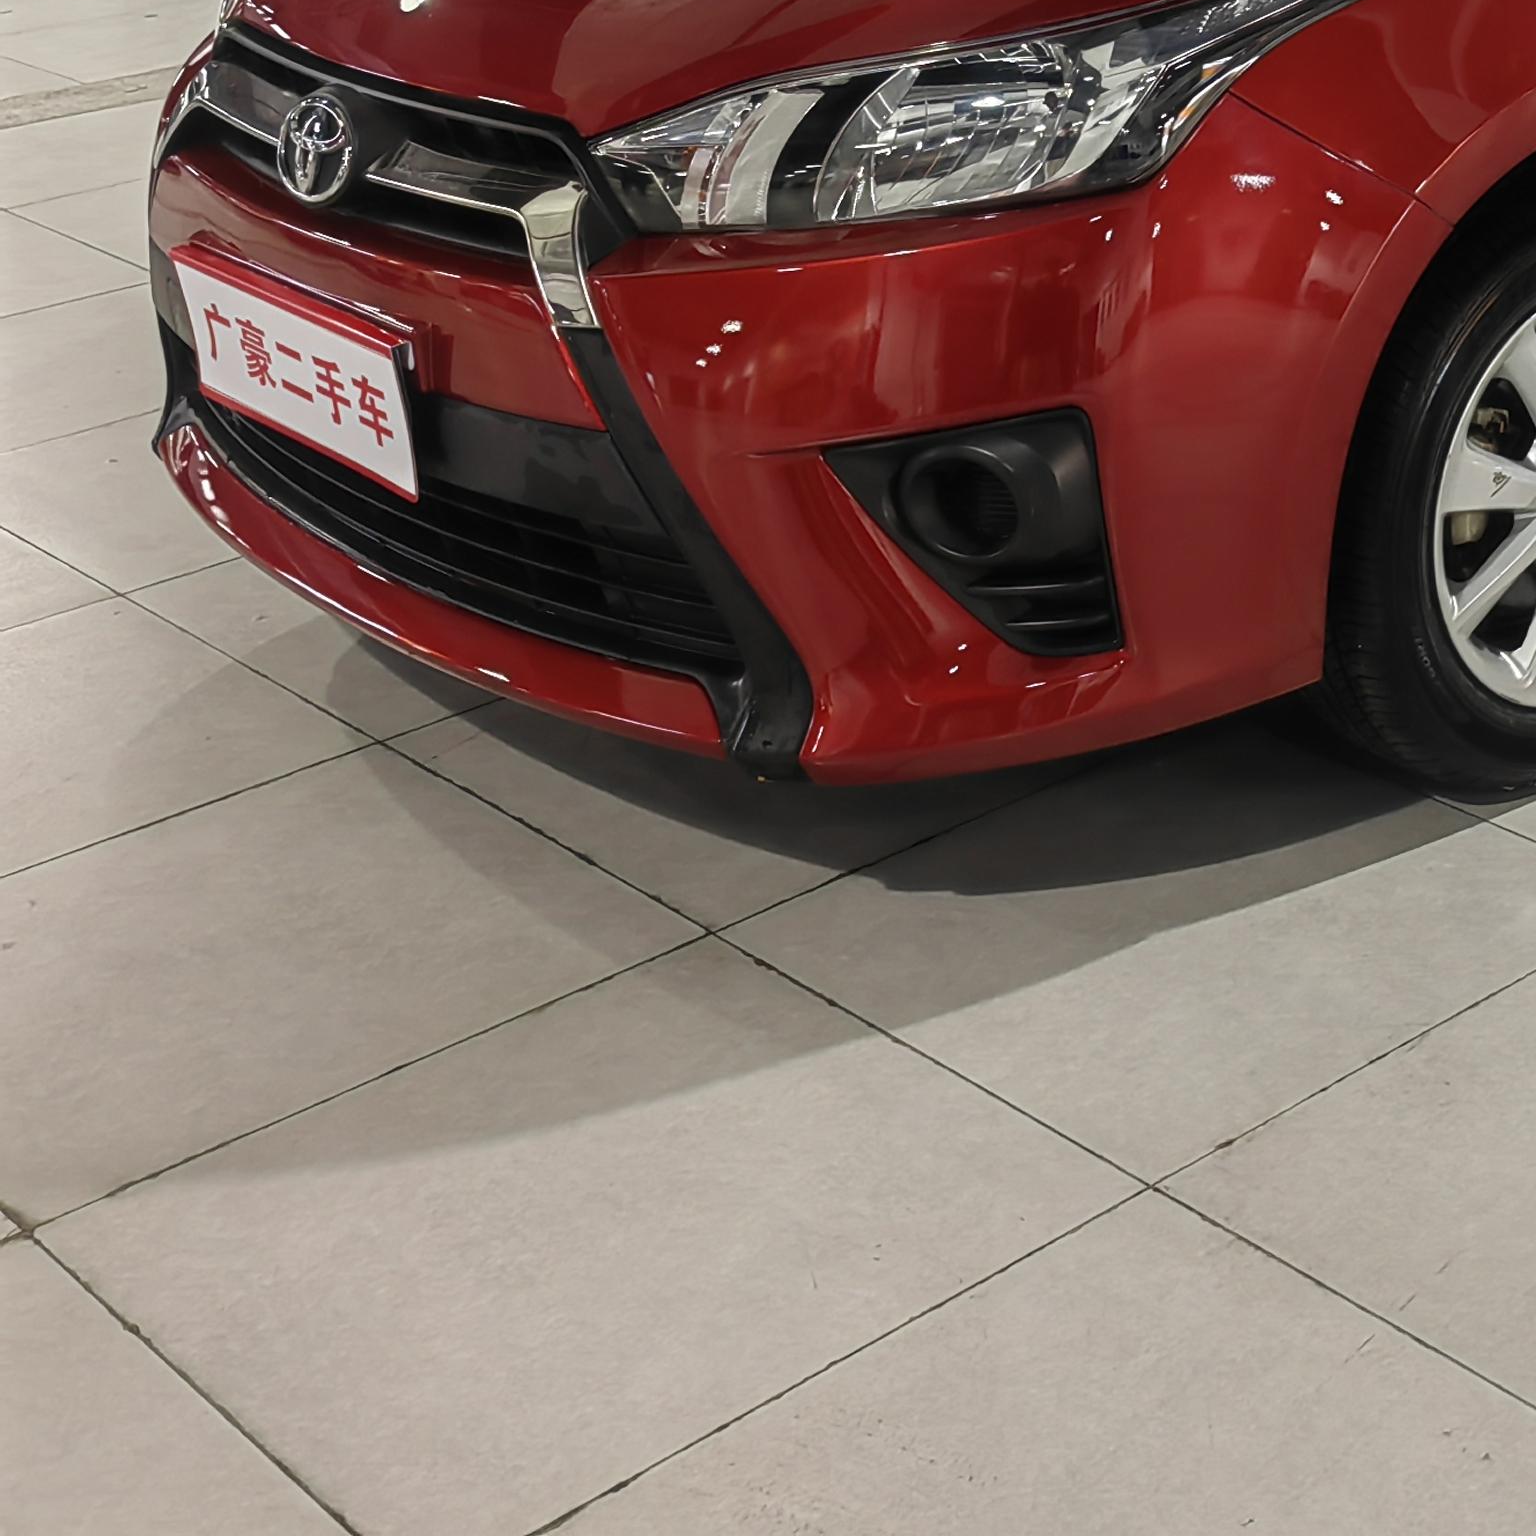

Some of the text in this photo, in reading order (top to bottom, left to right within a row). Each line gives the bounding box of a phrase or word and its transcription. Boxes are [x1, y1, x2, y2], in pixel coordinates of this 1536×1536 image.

[203, 303, 394, 447] 广豪二手车
